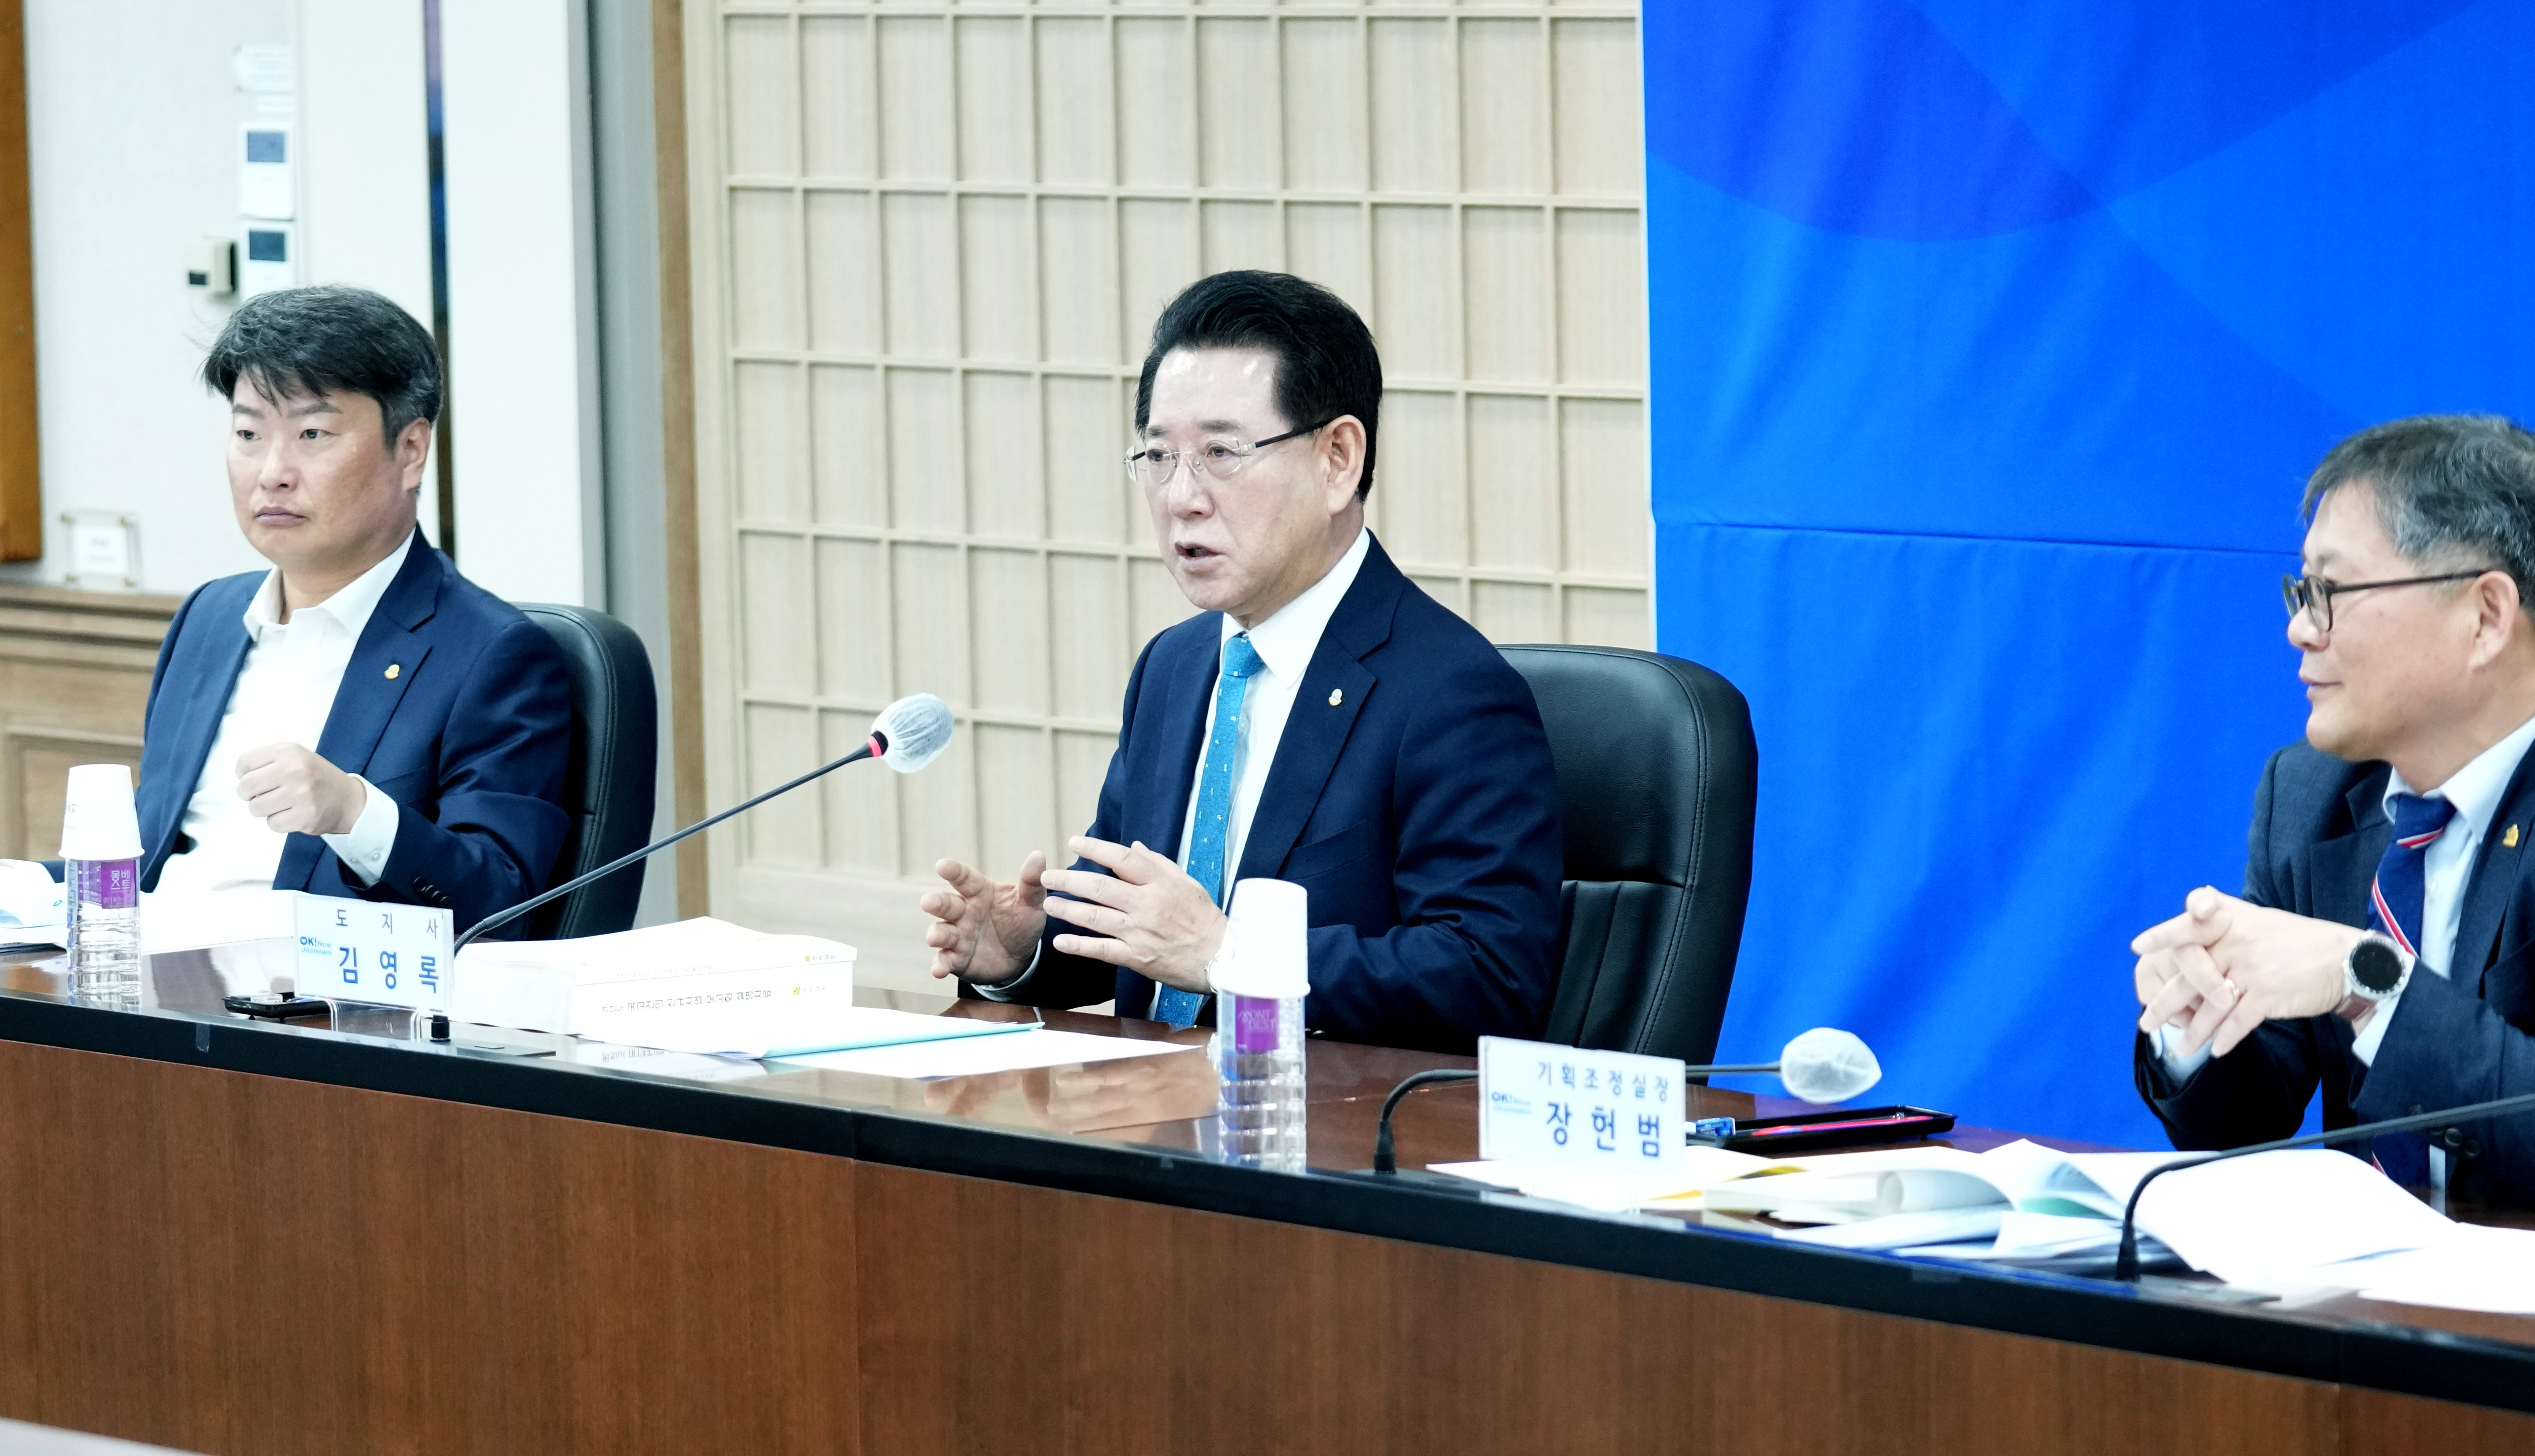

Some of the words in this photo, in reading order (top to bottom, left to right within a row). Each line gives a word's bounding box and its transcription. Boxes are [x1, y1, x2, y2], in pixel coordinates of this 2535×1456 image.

[300, 936, 317, 946] OK!
[301, 946, 332, 955] Jeonnam
[667, 996, 703, 1007] 신규사업
[707, 993, 732, 1003] 보고회
[737, 989, 771, 1000] 설명자료
[1537, 1061, 1668, 1102] 기획조정실장
[1546, 1102, 1660, 1157] 장헌범
